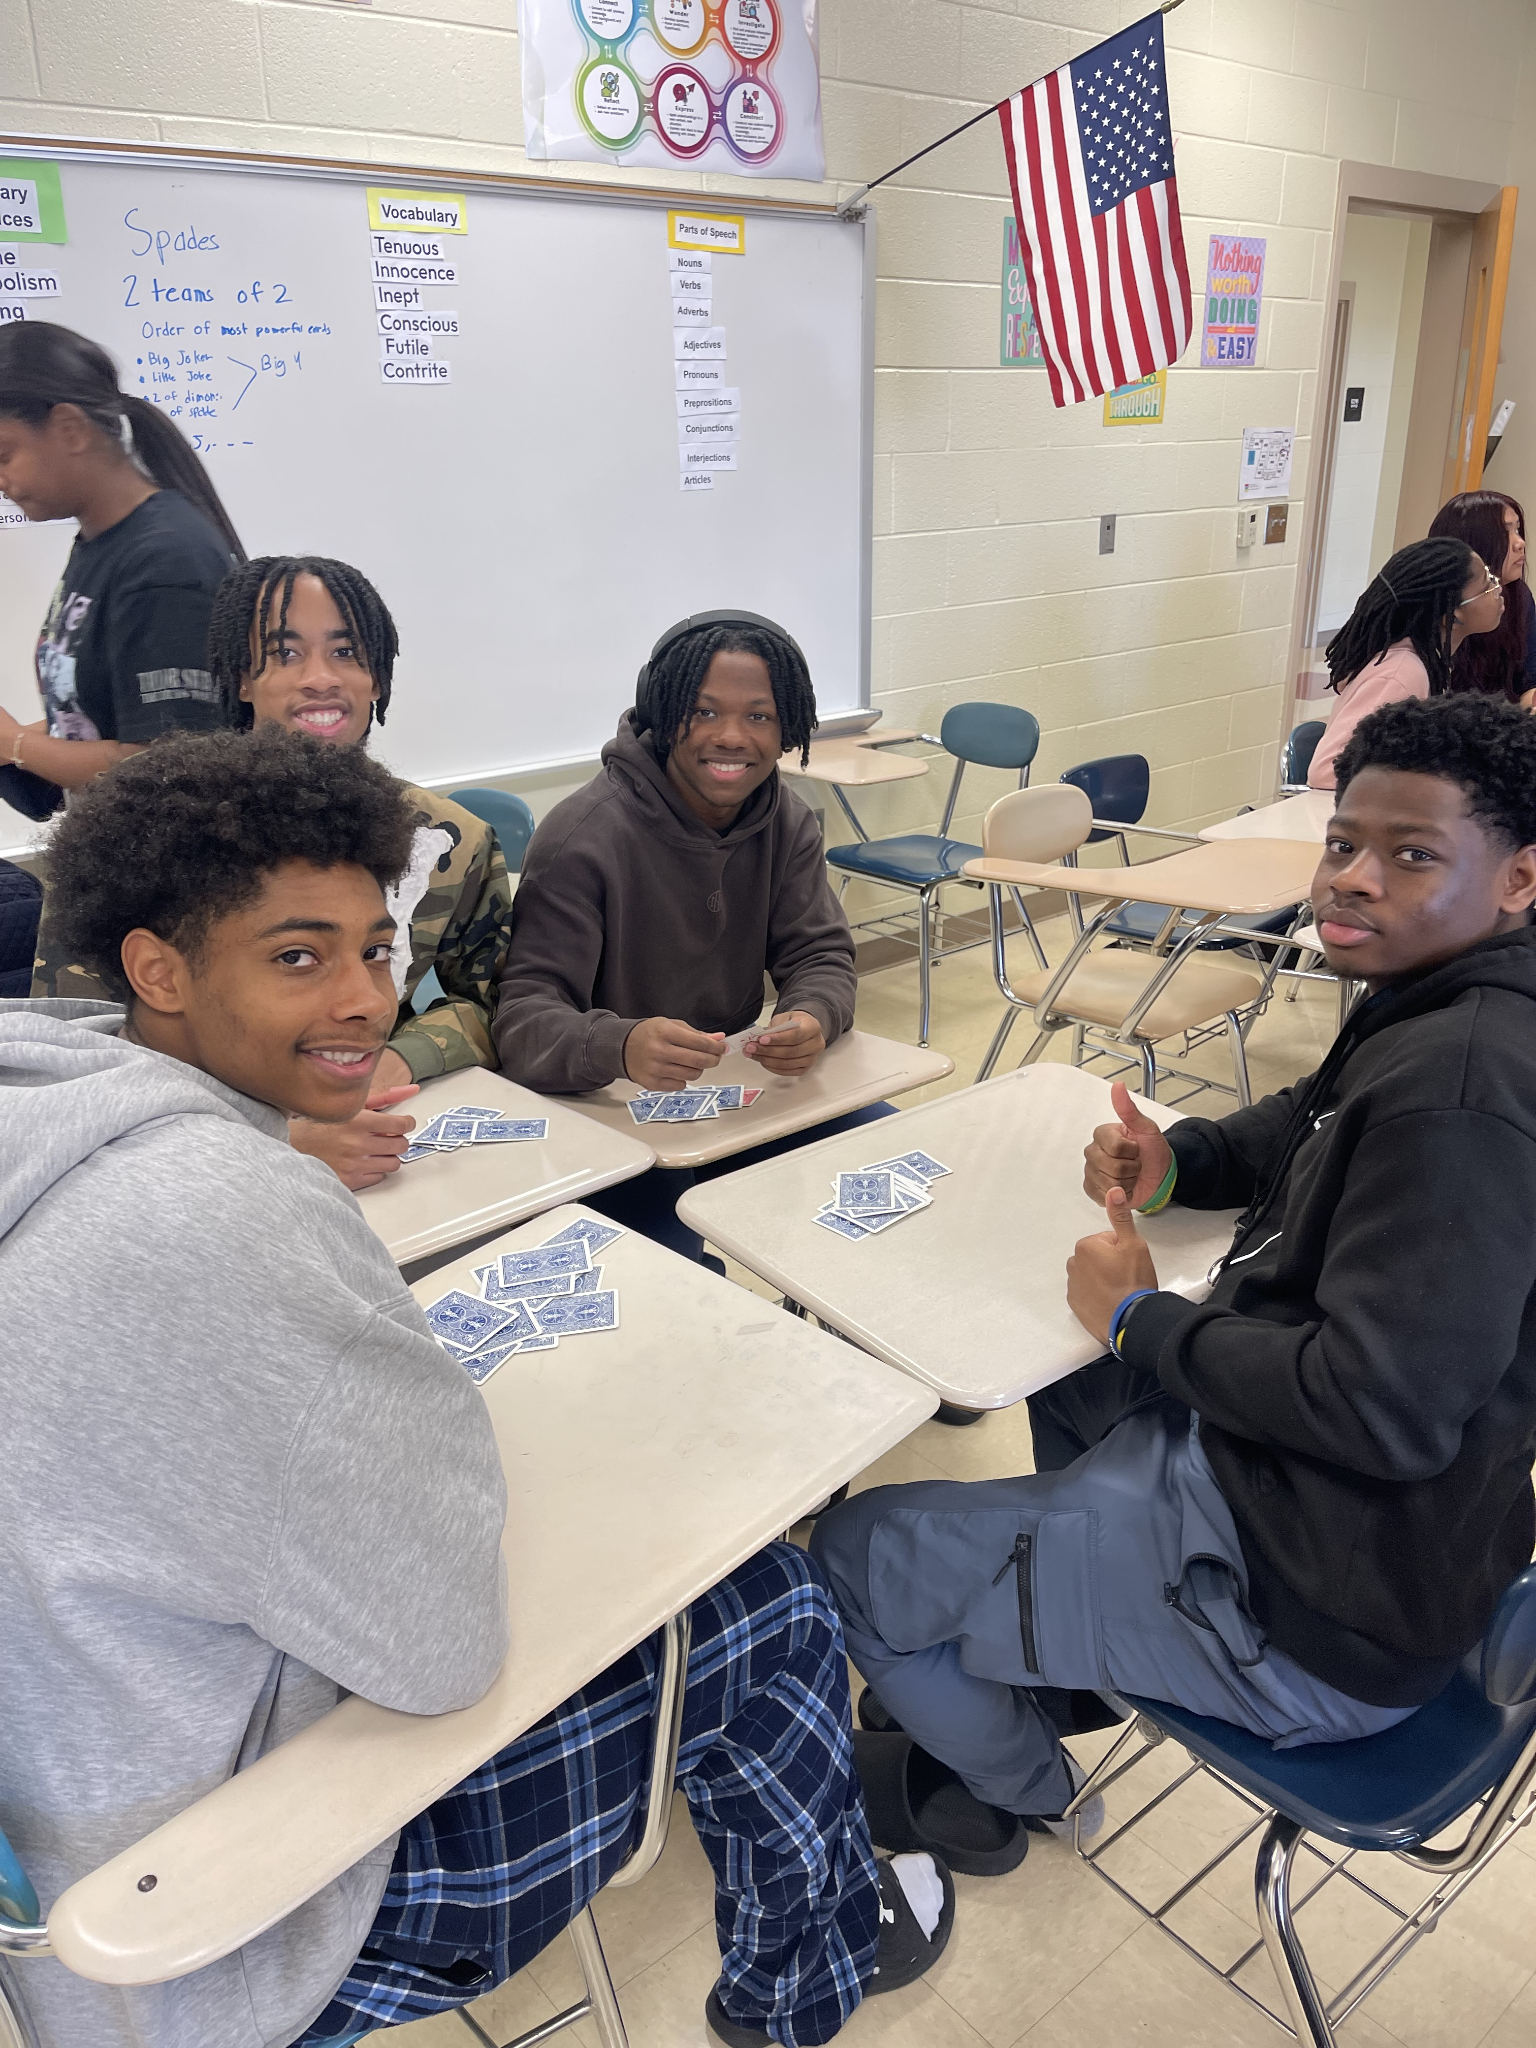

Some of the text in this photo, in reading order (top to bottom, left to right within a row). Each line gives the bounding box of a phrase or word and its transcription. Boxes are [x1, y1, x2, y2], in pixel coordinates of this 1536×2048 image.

[381, 204, 458, 226] Vocabulary
[124, 208, 220, 266] Spades
[679, 224, 737, 239] Parts of Speech
[374, 236, 439, 256] Tenuous
[375, 260, 455, 280] Innocence
[678, 258, 702, 268] Nouns
[1211, 240, 1262, 296] Nothing
[122, 274, 293, 307] 2 teams of 2
[680, 280, 702, 290] Verbs
[1211, 274, 1251, 294] worth
[378, 286, 420, 308] Inept
[678, 306, 708, 316] Adverbs
[1208, 297, 1258, 324] DOING
[142, 321, 185, 338] Order
[194, 320, 212, 335] of
[220, 322, 248, 336] most
[380, 314, 458, 332] Conscious
[386, 338, 430, 356] Futile
[684, 340, 722, 351] Adjectives
[1217, 336, 1255, 360] EASY
[148, 350, 213, 370] Big Joker
[260, 354, 286, 377] Big
[384, 362, 448, 378] Contrite
[684, 370, 718, 378] Pronouns
[153, 393, 161, 402] 2
[164, 390, 178, 400] of
[1110, 388, 1162, 418] THROUGH
[170, 406, 182, 416] of
[686, 424, 734, 434] Conjunctions
[687, 454, 730, 464] Interjections
[684, 475, 712, 485] Articles
